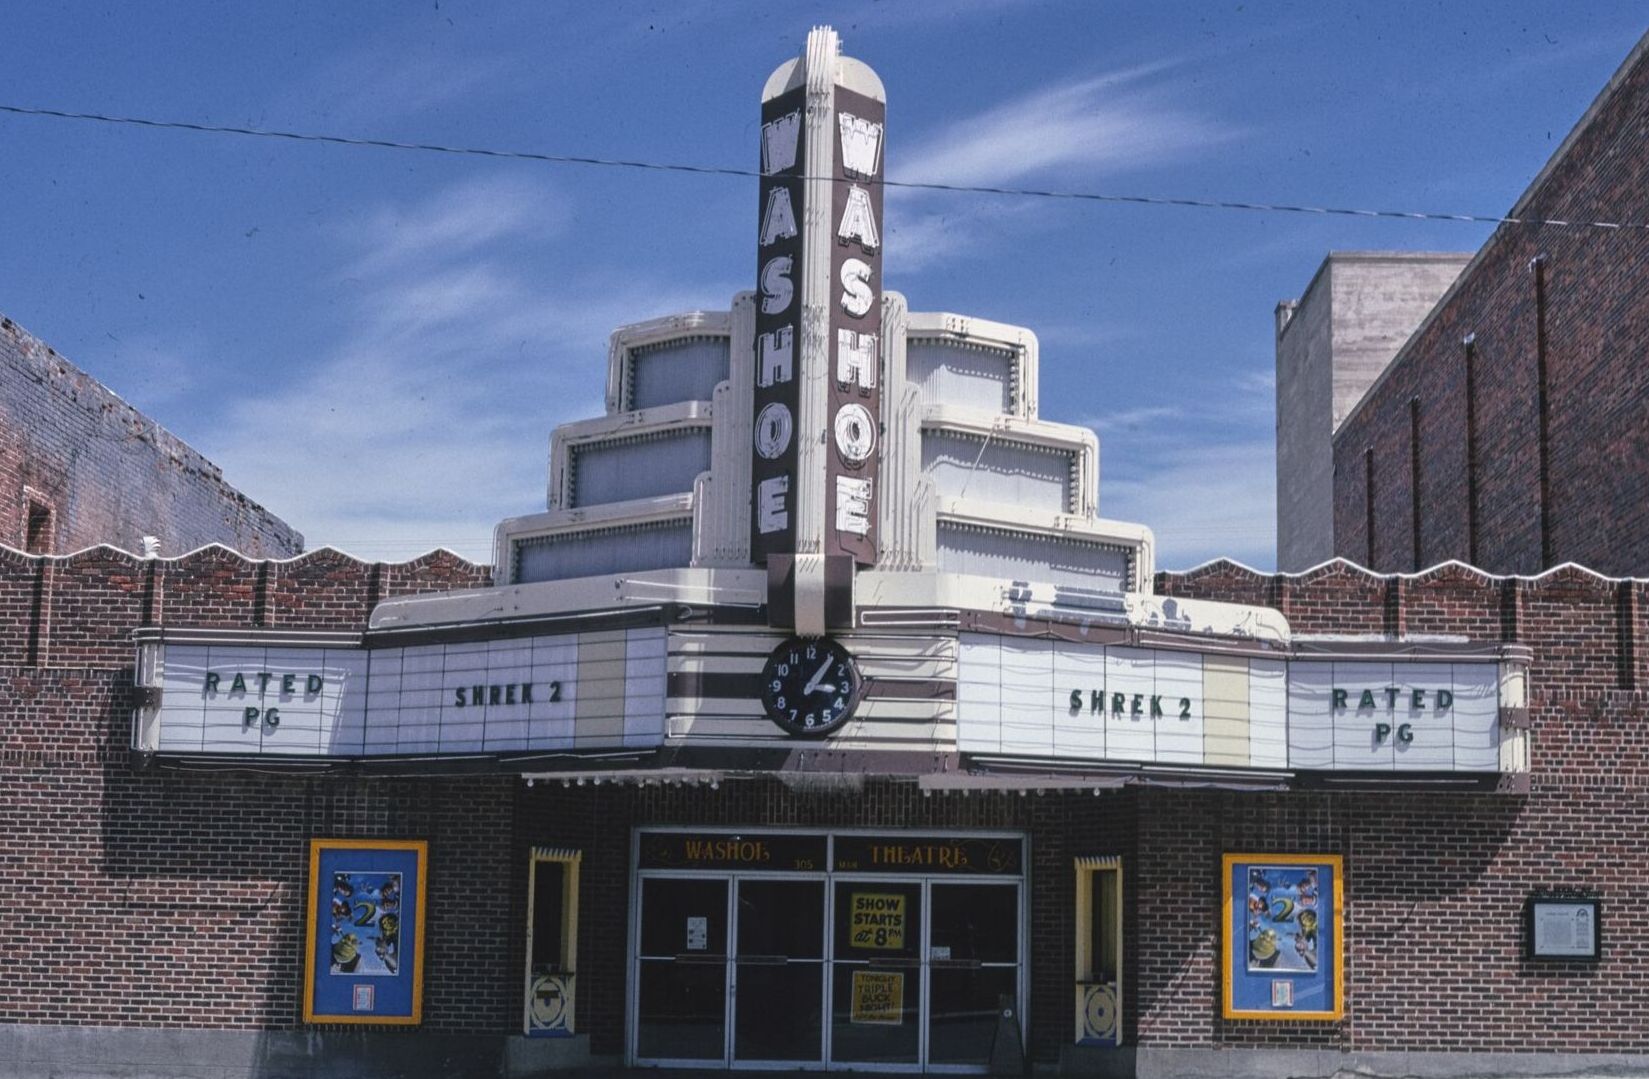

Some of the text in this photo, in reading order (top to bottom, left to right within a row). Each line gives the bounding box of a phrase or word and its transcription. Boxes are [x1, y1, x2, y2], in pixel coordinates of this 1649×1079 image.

[755, 109, 800, 534] WASHOE
[835, 112, 883, 535] WASHOE
[790, 653, 799, 665] 11
[806, 647, 816, 660] 12
[777, 664, 789, 677] 10
[838, 664, 845, 676] 2
[204, 672, 325, 695] RATED
[772, 680, 782, 692] 9
[840, 681, 850, 694] 3
[455, 681, 562, 708] SHREK 2
[1332, 688, 1455, 710] RATED
[777, 697, 786, 709] 8
[833, 697, 844, 710] 4
[1069, 689, 1192, 720] SHREK 2
[245, 707, 281, 728] PG
[789, 709, 798, 720] 7
[805, 714, 815, 726] 6
[822, 709, 832, 722] 5
[1376, 723, 1415, 743] PG
[685, 840, 968, 868] WASHOE THEATRE
[856, 897, 900, 911] SHOW
[1271, 897, 1295, 923] 2
[353, 902, 377, 927] 2
[854, 912, 902, 926] STARTS
[854, 928, 902, 947] at 8 PM
[858, 983, 894, 993] TRIPLE
